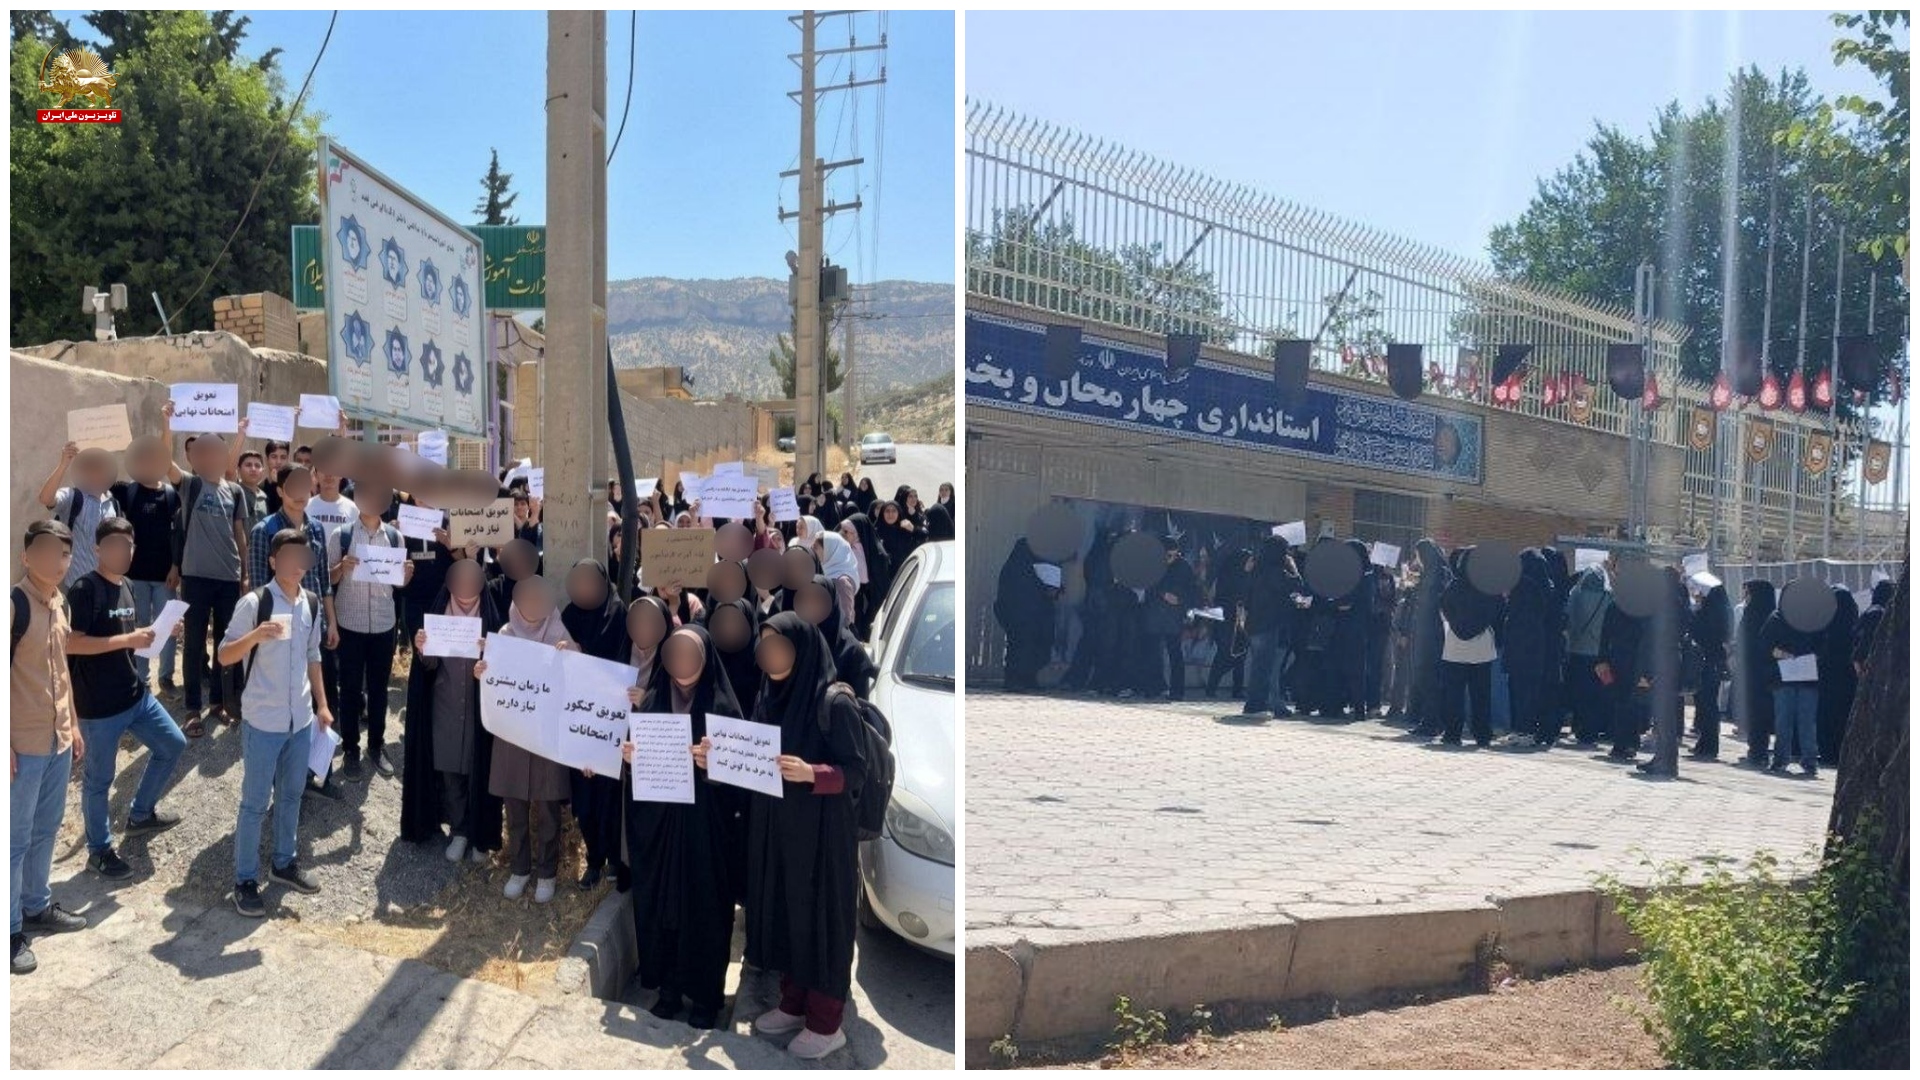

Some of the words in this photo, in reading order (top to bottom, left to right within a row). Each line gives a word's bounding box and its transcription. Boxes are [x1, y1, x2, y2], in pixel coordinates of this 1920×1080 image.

[508, 275, 546, 294] زارت
[1019, 376, 1038, 403] و
[193, 391, 216, 401] تعویق
[199, 407, 235, 416] امتحانات
[1197, 402, 1319, 442] استانداری
[450, 508, 484, 516] امتحانات
[486, 507, 509, 518] تعویق
[464, 524, 484, 535] داریم
[486, 524, 499, 535] نیاز
[486, 675, 517, 690] بیشتری
[518, 680, 540, 694] زمان
[542, 683, 551, 693] ما
[496, 696, 519, 709] داریم
[521, 701, 536, 713] نیاز
[564, 700, 595, 712] کنکور
[596, 706, 627, 721] تعویق
[569, 723, 613, 742] امتحانات
[728, 732, 753, 742] امتحانات
[614, 737, 621, 748] و
[754, 737, 771, 747] تعویق
